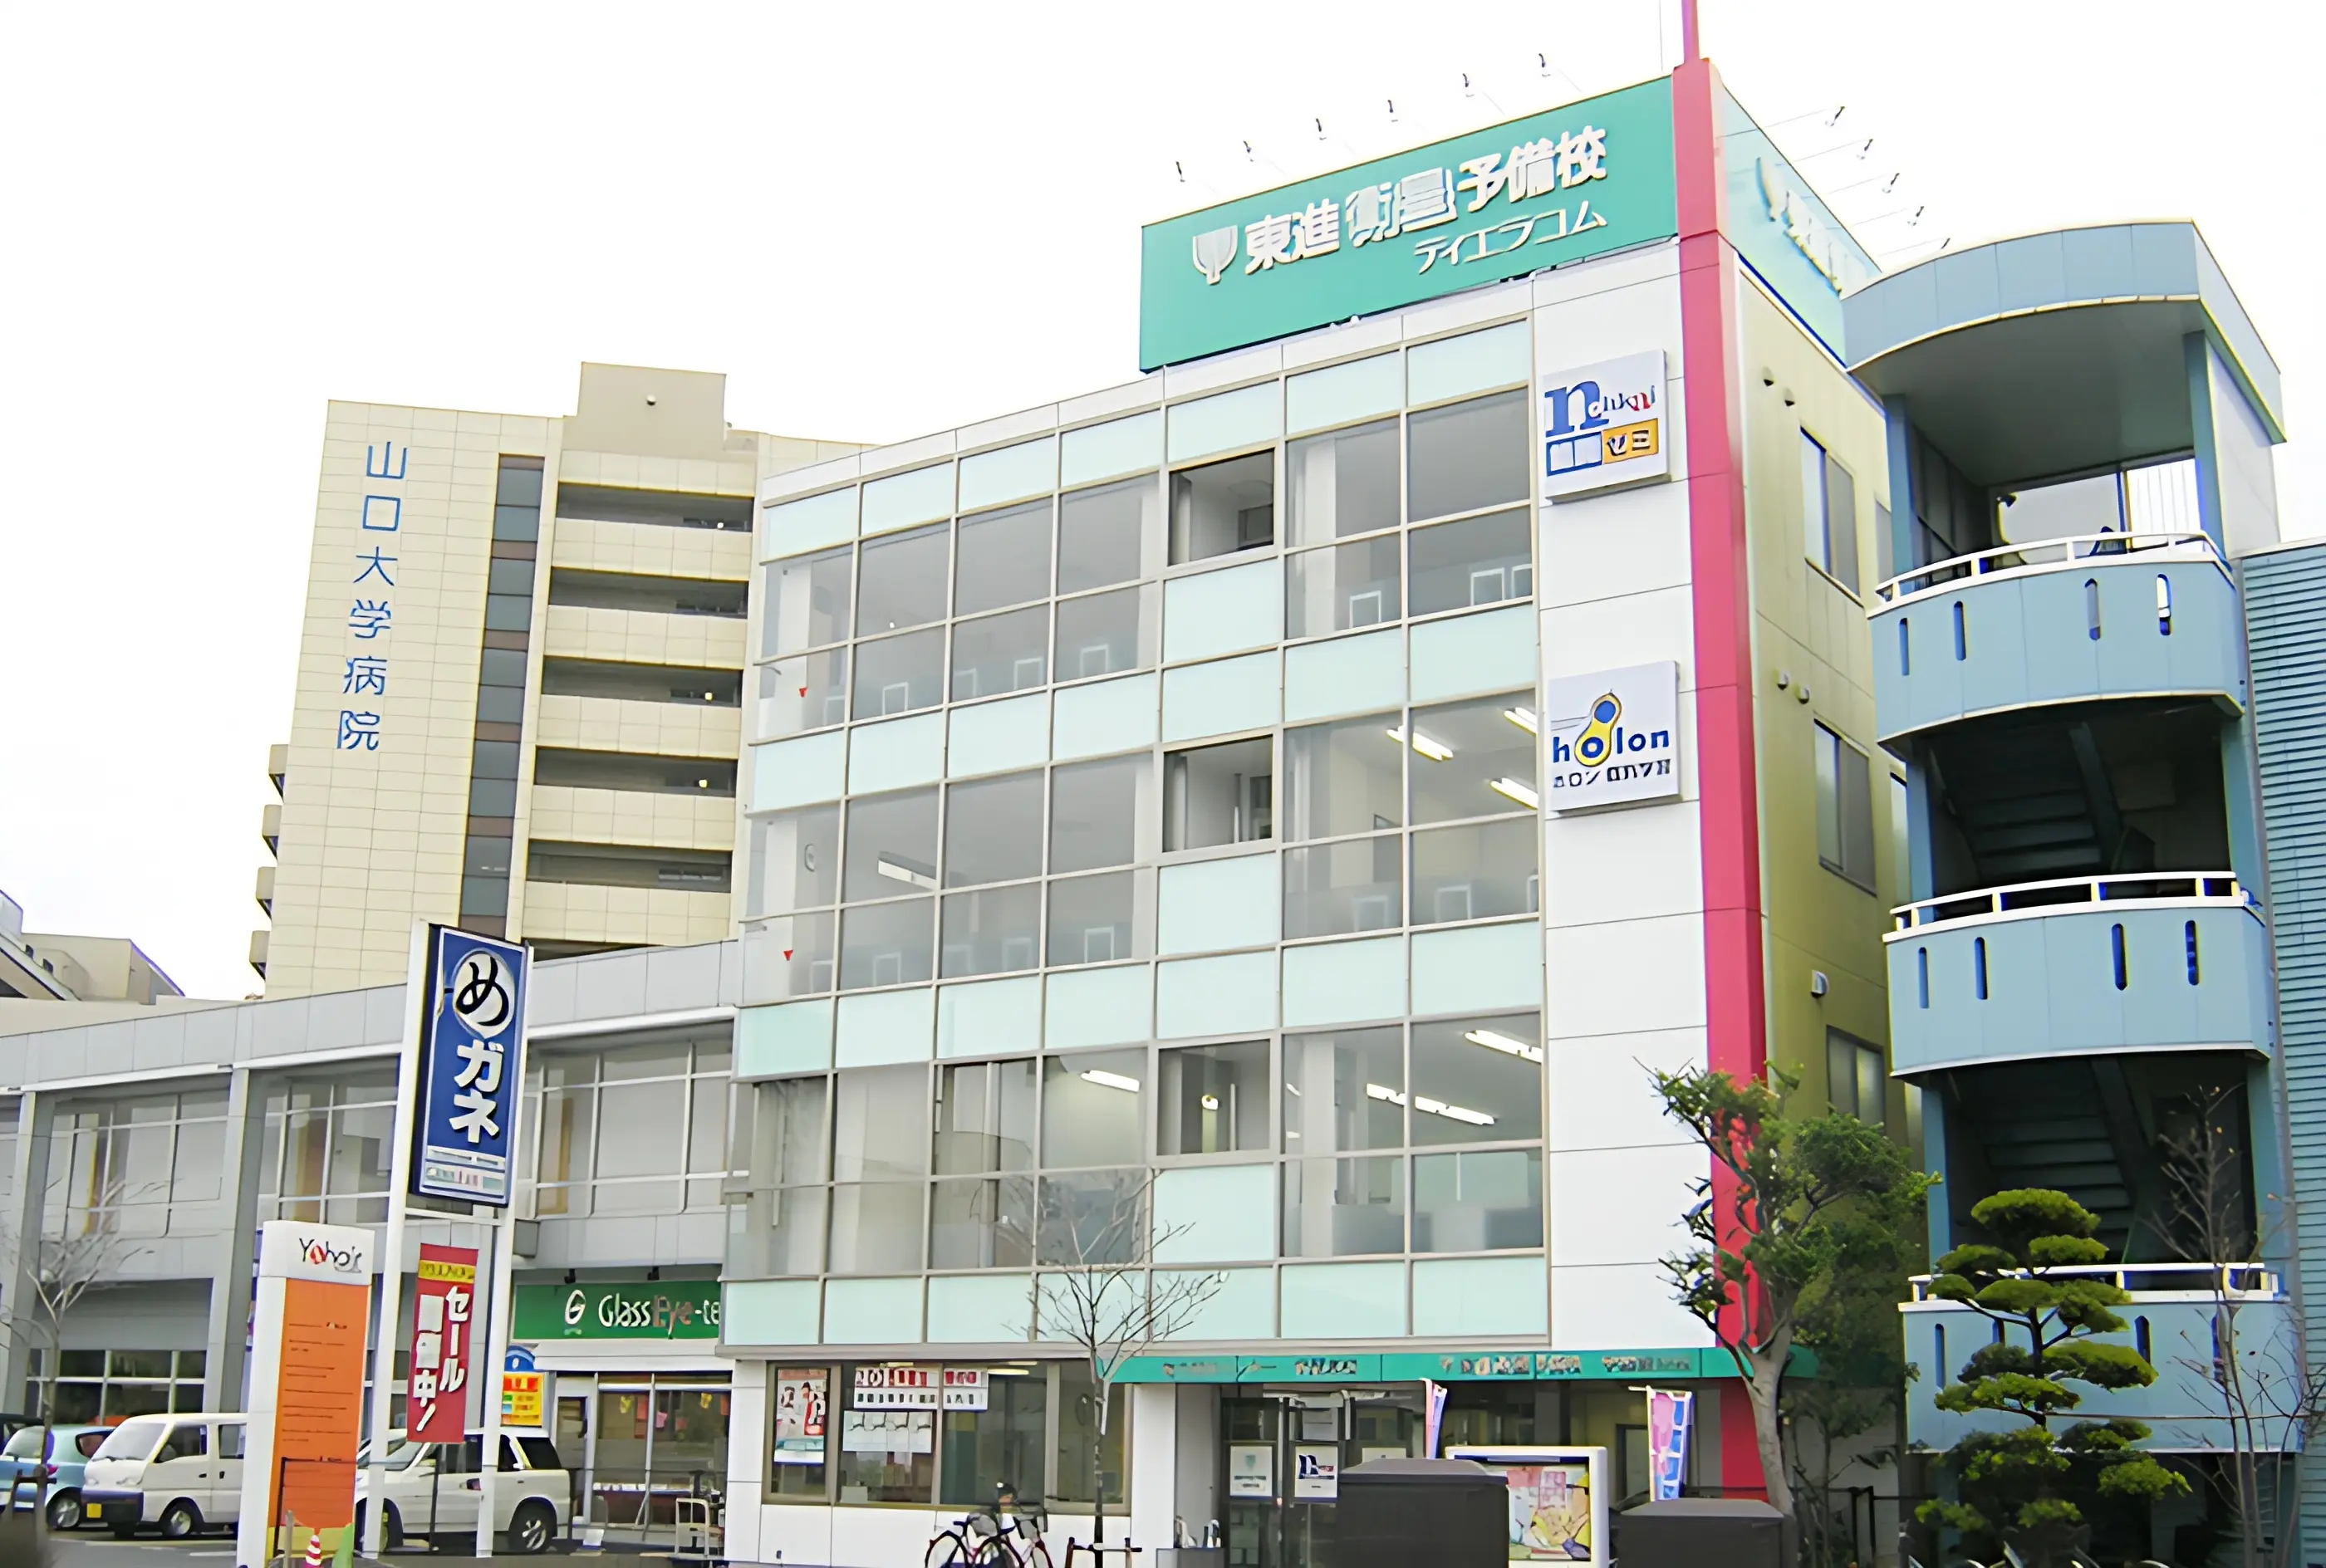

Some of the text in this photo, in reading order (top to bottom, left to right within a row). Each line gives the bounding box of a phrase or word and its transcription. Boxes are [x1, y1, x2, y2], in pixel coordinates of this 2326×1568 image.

[336, 441, 408, 750] 山口大学病院
[1553, 727, 1670, 763] holon
[449, 956, 509, 1144] めガネ
[439, 1286, 469, 1393] セール
